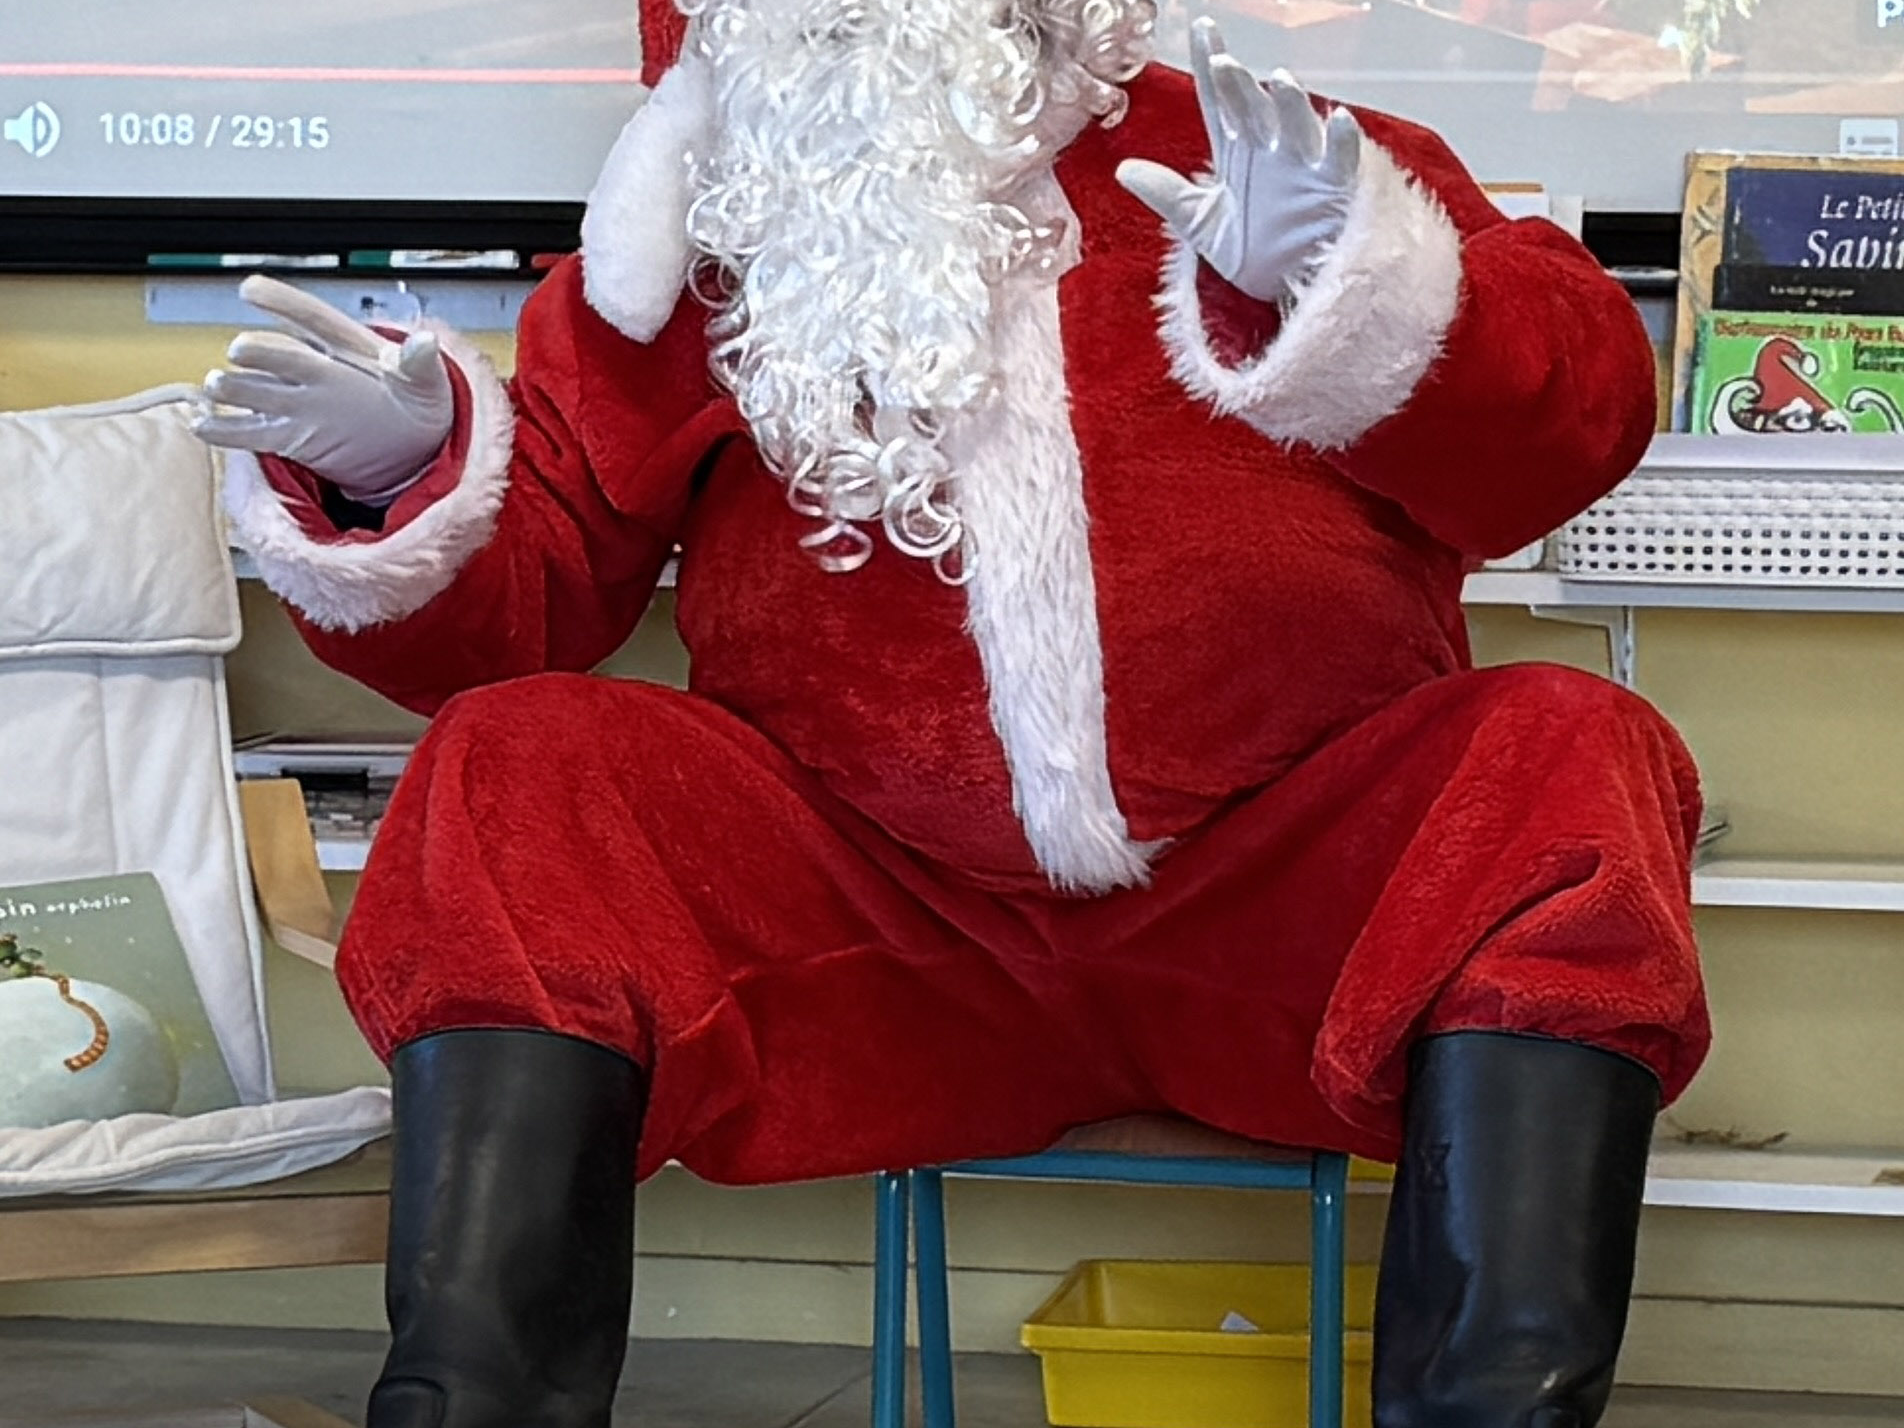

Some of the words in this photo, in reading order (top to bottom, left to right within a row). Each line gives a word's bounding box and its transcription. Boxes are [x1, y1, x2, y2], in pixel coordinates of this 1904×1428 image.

[99, 112, 195, 145] 10:08
[232, 115, 330, 149] 29:15
[1820, 194, 1848, 220] Le
